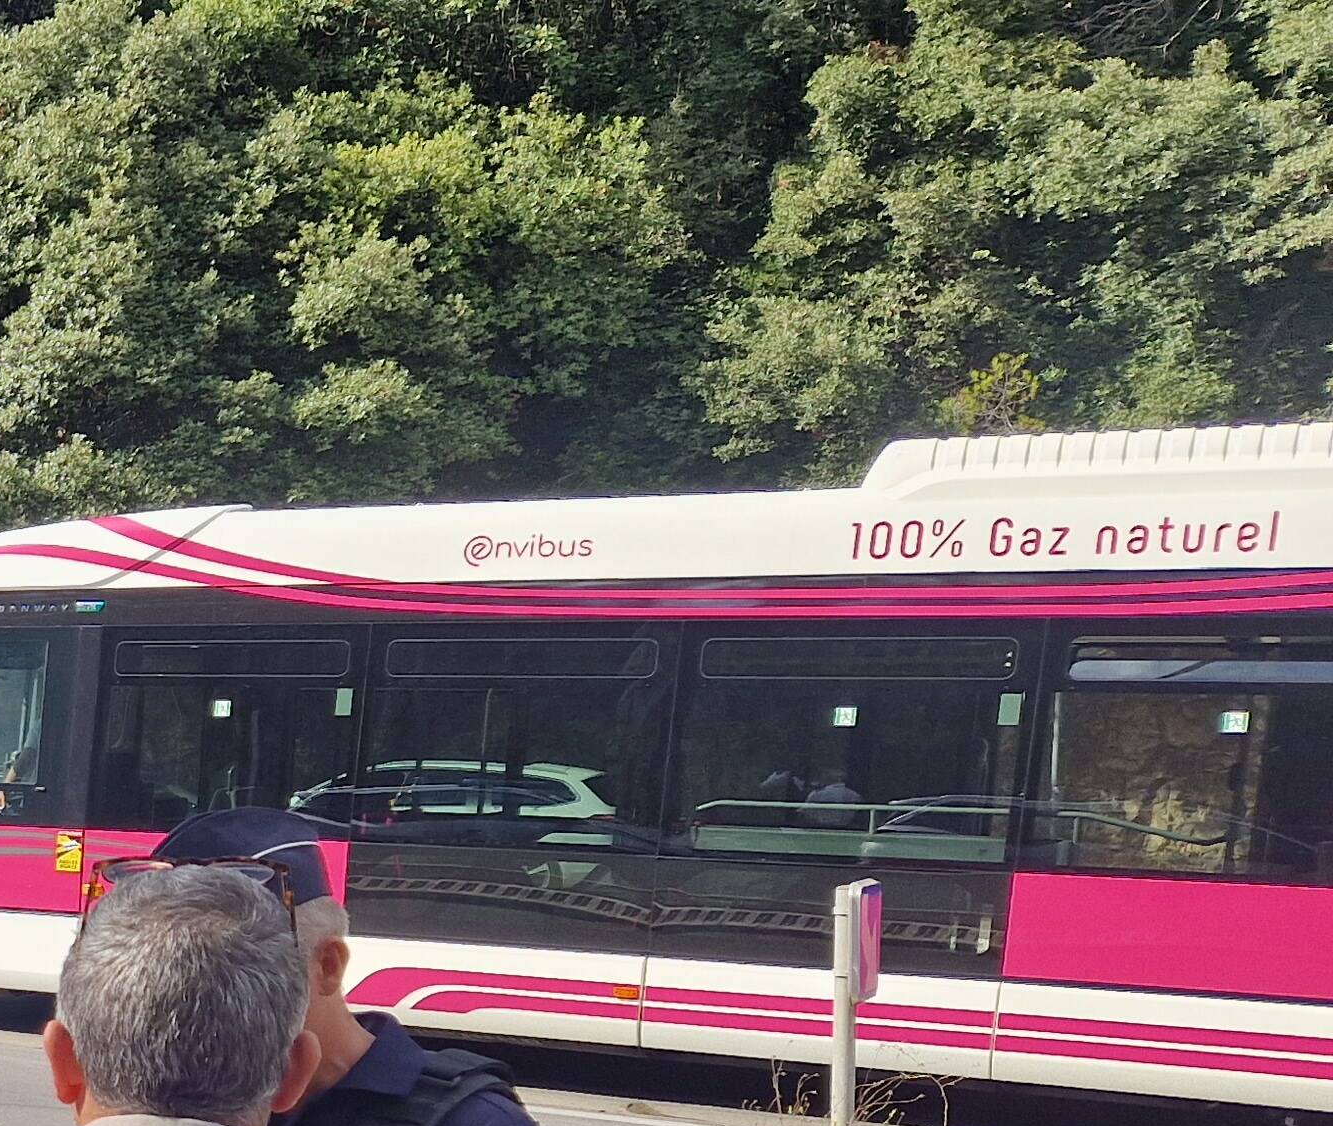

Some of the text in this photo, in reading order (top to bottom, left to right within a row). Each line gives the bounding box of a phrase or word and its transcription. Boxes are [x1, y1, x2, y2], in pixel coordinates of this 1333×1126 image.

[851, 510, 1281, 561] 100% Gaz naturel
